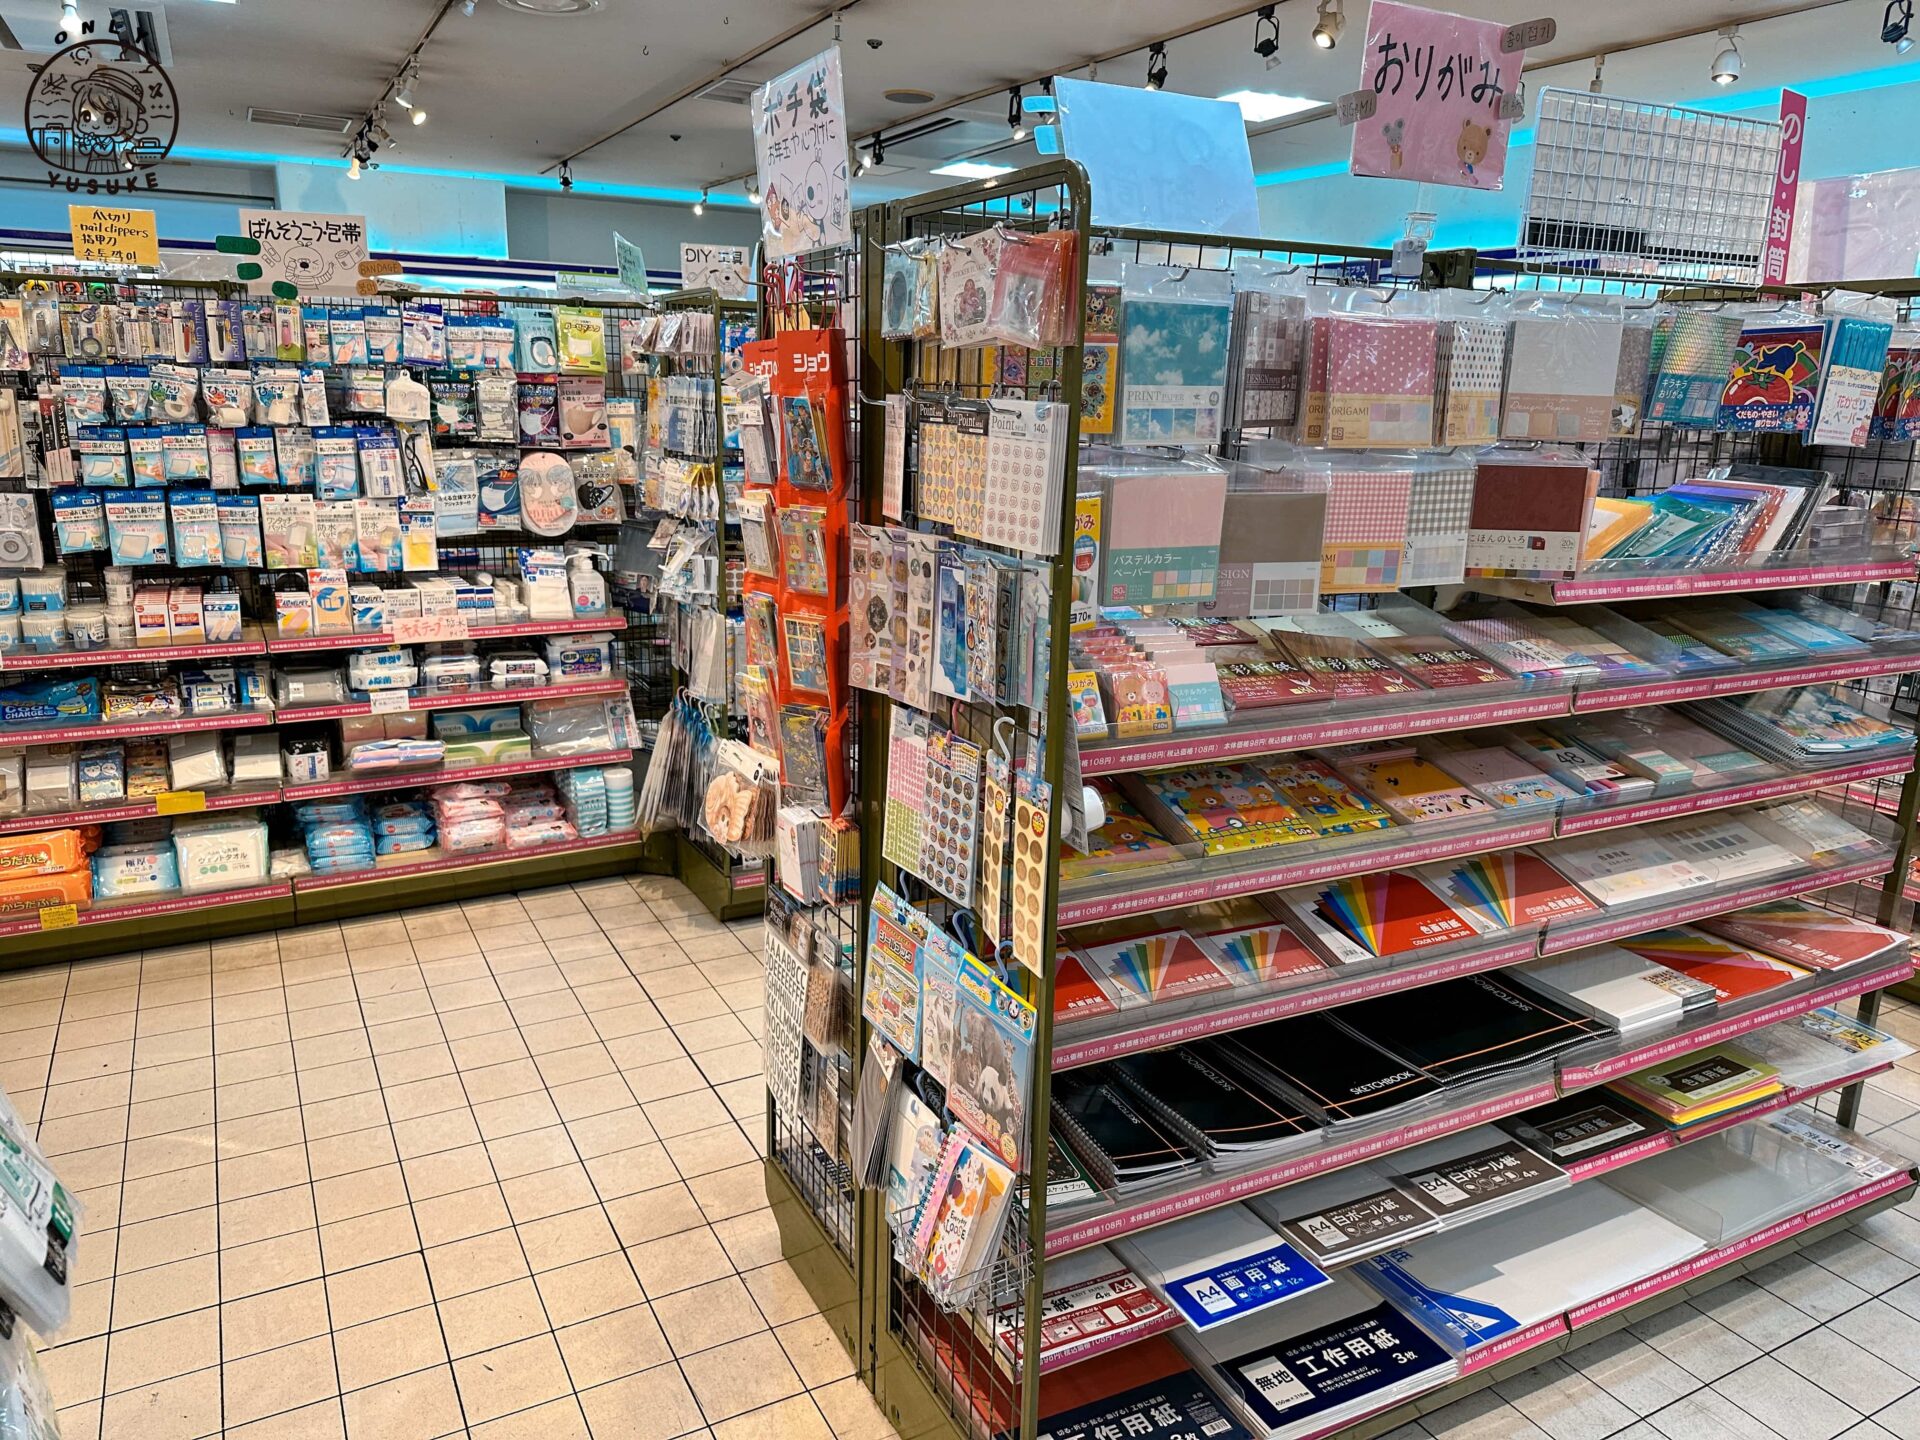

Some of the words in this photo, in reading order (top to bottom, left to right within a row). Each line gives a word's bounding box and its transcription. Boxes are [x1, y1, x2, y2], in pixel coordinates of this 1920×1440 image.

[1374, 33, 1503, 108] おりがみ
[763, 67, 829, 136] ポチ袋
[767, 119, 836, 167] お年玉や心づけに
[1765, 113, 1802, 282] のし・封筒
[93, 209, 131, 224] 爪切り
[80, 223, 102, 233] nail
[105, 223, 149, 238] clippers
[81, 233, 117, 246] 指甲刀
[248, 219, 362, 244] ばんそうこう・包帯
[561, 276, 576, 286] A4
[793, 351, 830, 373] ショウ
[1661, 378, 1688, 388] キラキラ
[1127, 390, 1161, 402] PRINT
[1658, 389, 1684, 400] おりがみ
[1836, 394, 1866, 412] 花かざり
[919, 404, 937, 417] Point
[957, 413, 975, 427] Point
[1331, 406, 1369, 416] ORIGAMI
[991, 416, 1015, 431] Point
[1113, 554, 1182, 567] パステルカラー
[1113, 567, 1151, 578] ペーパー
[401, 619, 442, 638] キズテープ
[1120, 708, 1168, 721] おりがみ
[1119, 742, 1219, 764] 本体価格98円(税込価格108円)
[1223, 730, 1319, 751] 本体価格98円(税込価格108円)
[1556, 752, 1585, 765] 48
[1110, 885, 1208, 911] 本体価格98円(税込価格108円)
[1419, 917, 1463, 935] 色画用紙
[1112, 1022, 1208, 1051] 本体価格98円(税込価格108円)
[1209, 1003, 1299, 1028] 本体価格98円(税込価格108円)
[1350, 1070, 1414, 1096] SKETCHBOOK
[1681, 1064, 1732, 1086] 色画用紙
[1553, 1116, 1613, 1141] 色画用紙
[1450, 1155, 1521, 1185] 白ボール紙
[1129, 1188, 1226, 1223] 本体価格98円(税込価格108円)
[1229, 1161, 1318, 1193] 本体価格98円(税込価格108円)
[1421, 1174, 1448, 1193] B4
[1331, 1200, 1400, 1228] 白ボール紙
[1307, 1220, 1332, 1236] A4
[1220, 1258, 1292, 1291] 画用紙
[1113, 1278, 1137, 1294] A4
[1196, 1284, 1223, 1303] A4
[1295, 1327, 1400, 1378] 工作用紙
[1391, 1349, 1419, 1365] 3枚
[1253, 1368, 1295, 1392] 無地
